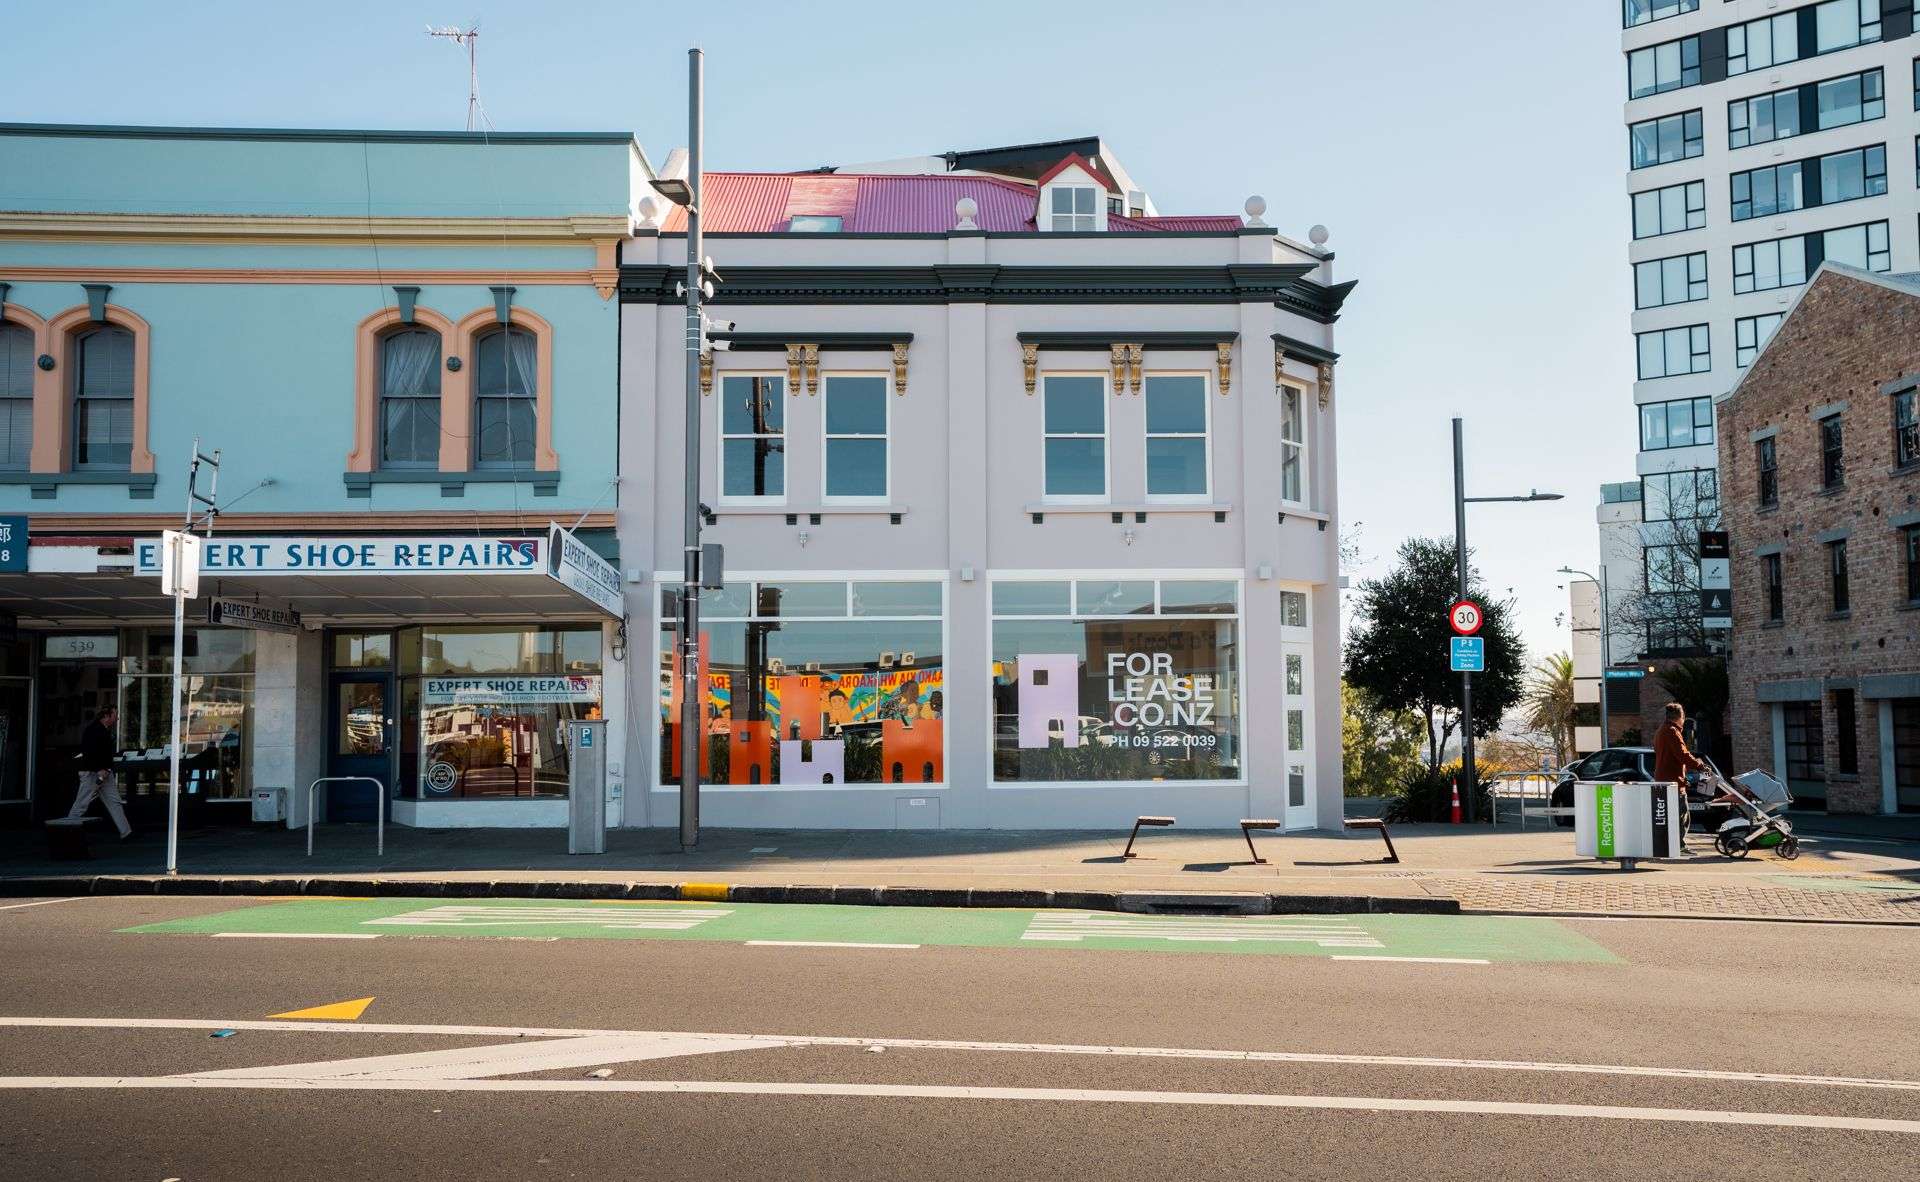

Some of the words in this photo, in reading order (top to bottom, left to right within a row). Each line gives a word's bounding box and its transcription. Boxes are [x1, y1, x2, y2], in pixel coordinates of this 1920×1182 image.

[140, 544, 271, 567] EERT
[287, 544, 377, 567] SHOE
[564, 539, 587, 567] EXPERT
[223, 602, 251, 619] EXPERT
[252, 607, 271, 621] SHOE
[1458, 611, 1475, 624] 30
[70, 641, 95, 653] 539
[1108, 653, 1173, 676] FOR
[428, 681, 482, 692] EXPERT
[487, 680, 524, 692] SHOE
[1108, 678, 1212, 701] LEASE
[582, 728, 591, 738] P
[1112, 736, 1129, 747] PH
[1133, 736, 1150, 747] 09
[1154, 736, 1178, 747] 522
[1183, 736, 1216, 747] 0039
[1600, 797, 1612, 846] Recycling
[1656, 798, 1665, 825] Litter
